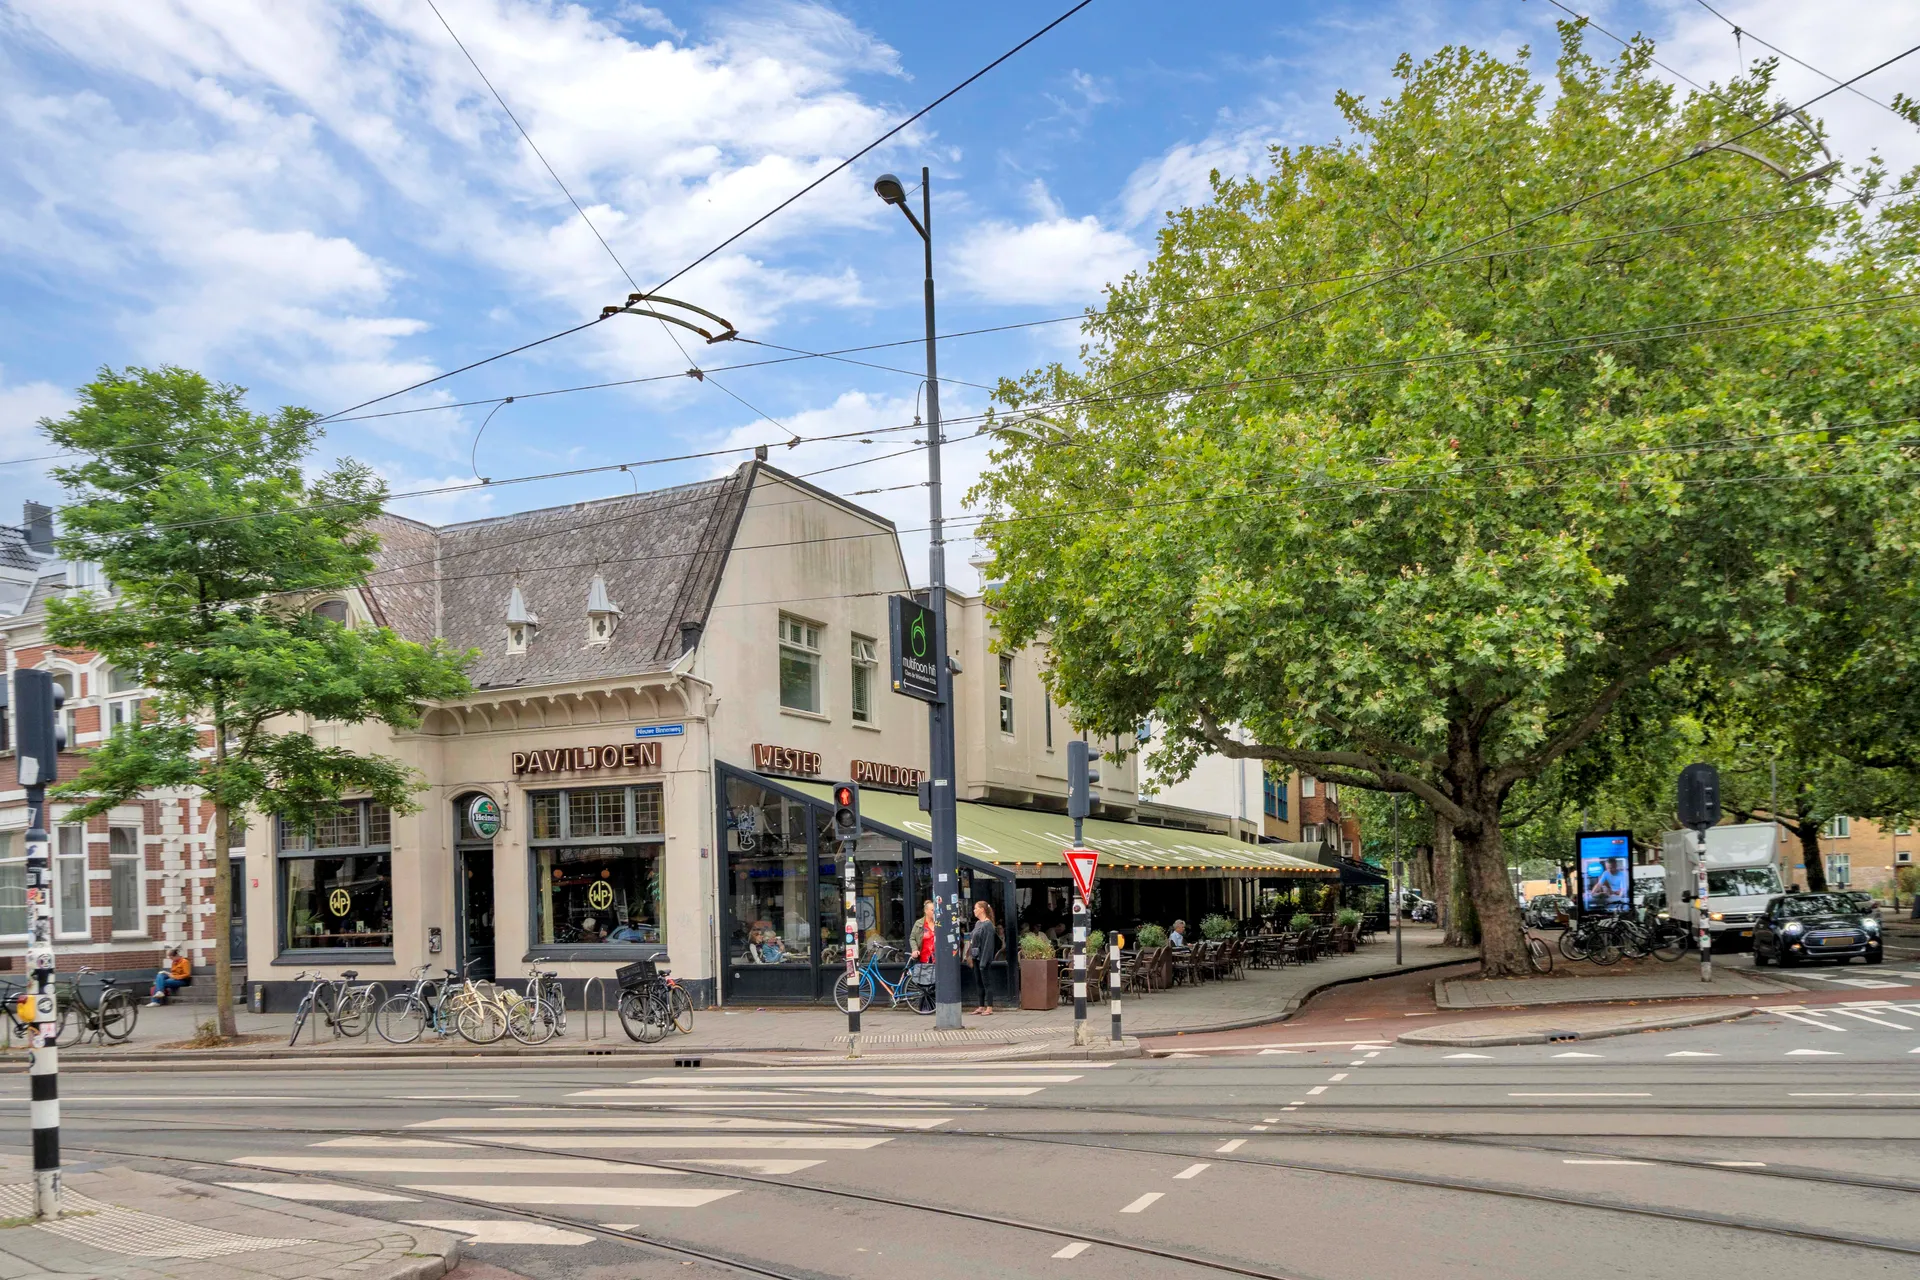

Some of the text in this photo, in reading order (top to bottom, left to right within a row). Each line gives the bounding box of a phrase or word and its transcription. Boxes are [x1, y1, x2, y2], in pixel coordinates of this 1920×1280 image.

[655, 726, 682, 734] Binnenweg
[512, 743, 658, 774] PAVILJOEN
[758, 744, 822, 773] WESTER
[855, 760, 926, 788] PAVILJOEN
